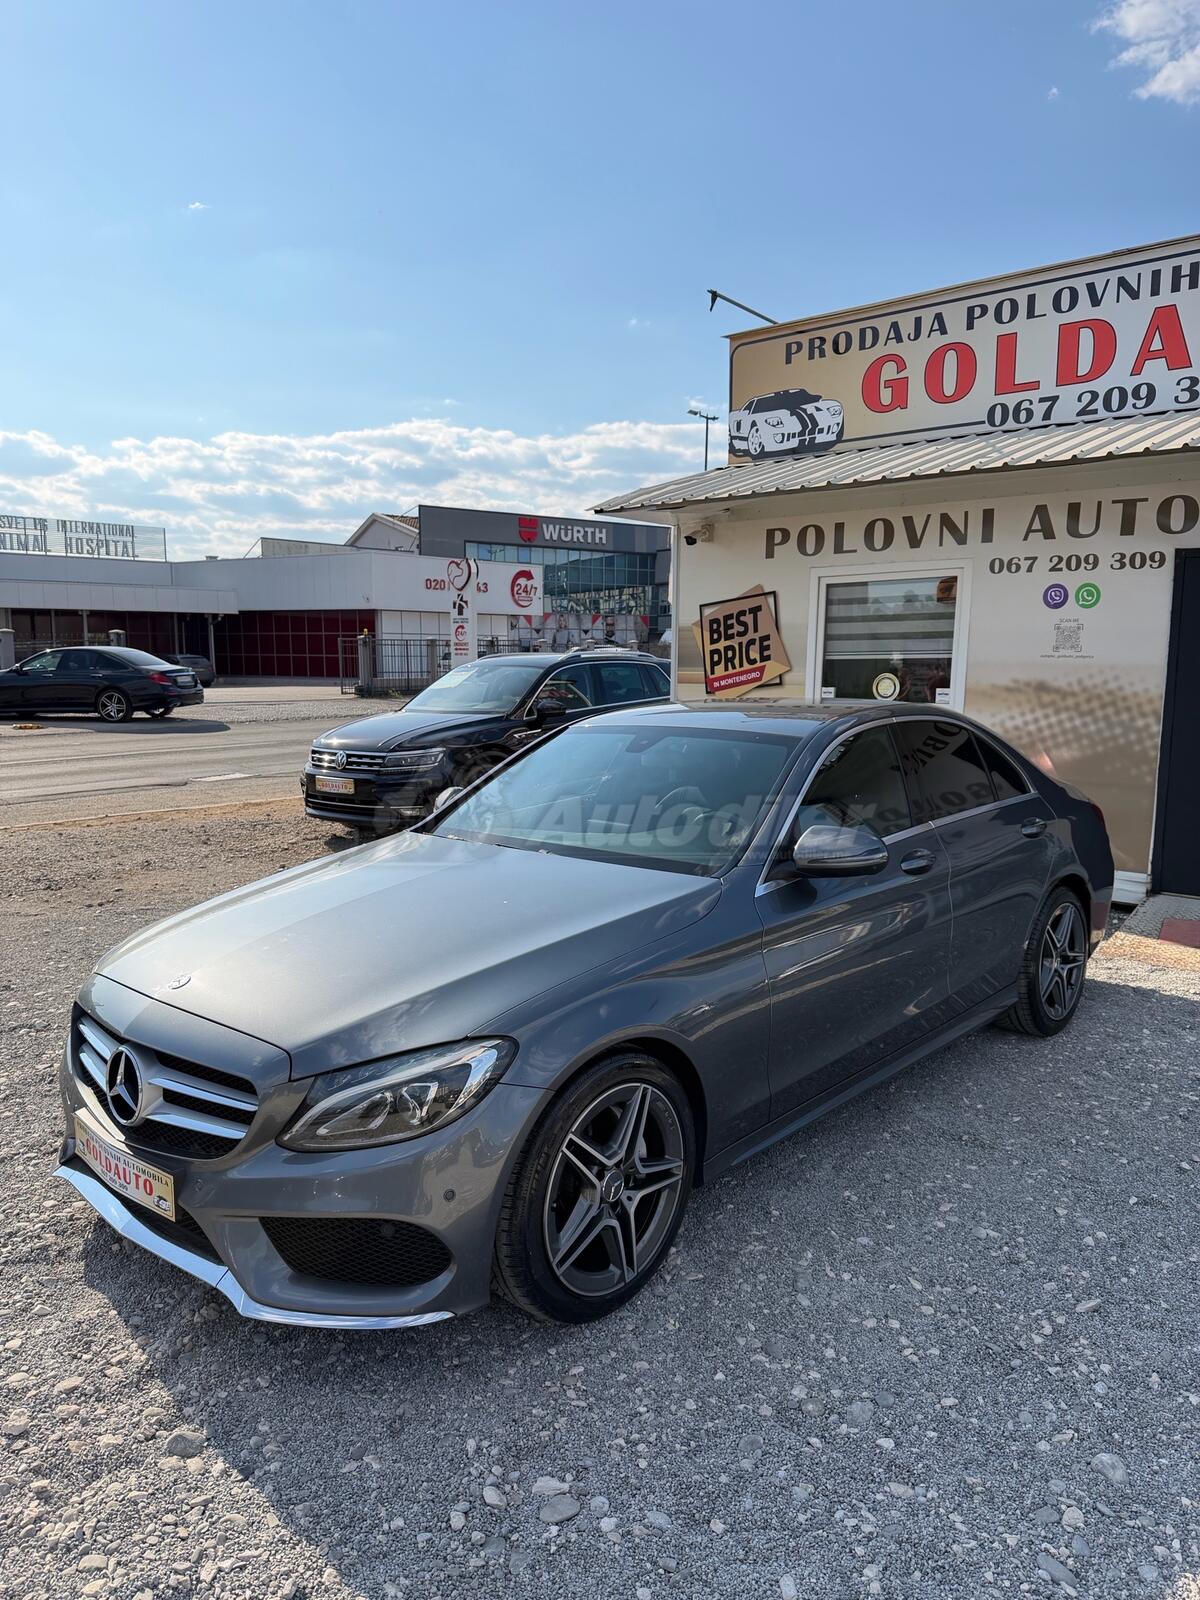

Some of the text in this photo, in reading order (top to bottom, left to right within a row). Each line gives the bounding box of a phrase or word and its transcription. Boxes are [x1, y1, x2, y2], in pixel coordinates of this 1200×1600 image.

[785, 260, 1200, 365] PRODAJA POLOVNIH
[861, 303, 1193, 415] GOLDA
[986, 396, 1060, 428] 067
[1076, 382, 1157, 417] 209
[56, 519, 137, 537] INTERNATIONAL
[542, 522, 607, 545] WÜRTH
[764, 494, 1200, 560] POLOVNI AUTO
[65, 536, 139, 558] HOSPITAL
[988, 550, 1167, 575] 067 209 309
[425, 578, 446, 590] 020
[515, 583, 538, 597] 24/7
[709, 605, 762, 645] BEST
[709, 634, 771, 675] PRICE
[721, 671, 760, 685] MONTENEGRO
[85, 1137, 154, 1197] GOLDAUTO
[122, 1158, 169, 1188] AUTOMOBILA
